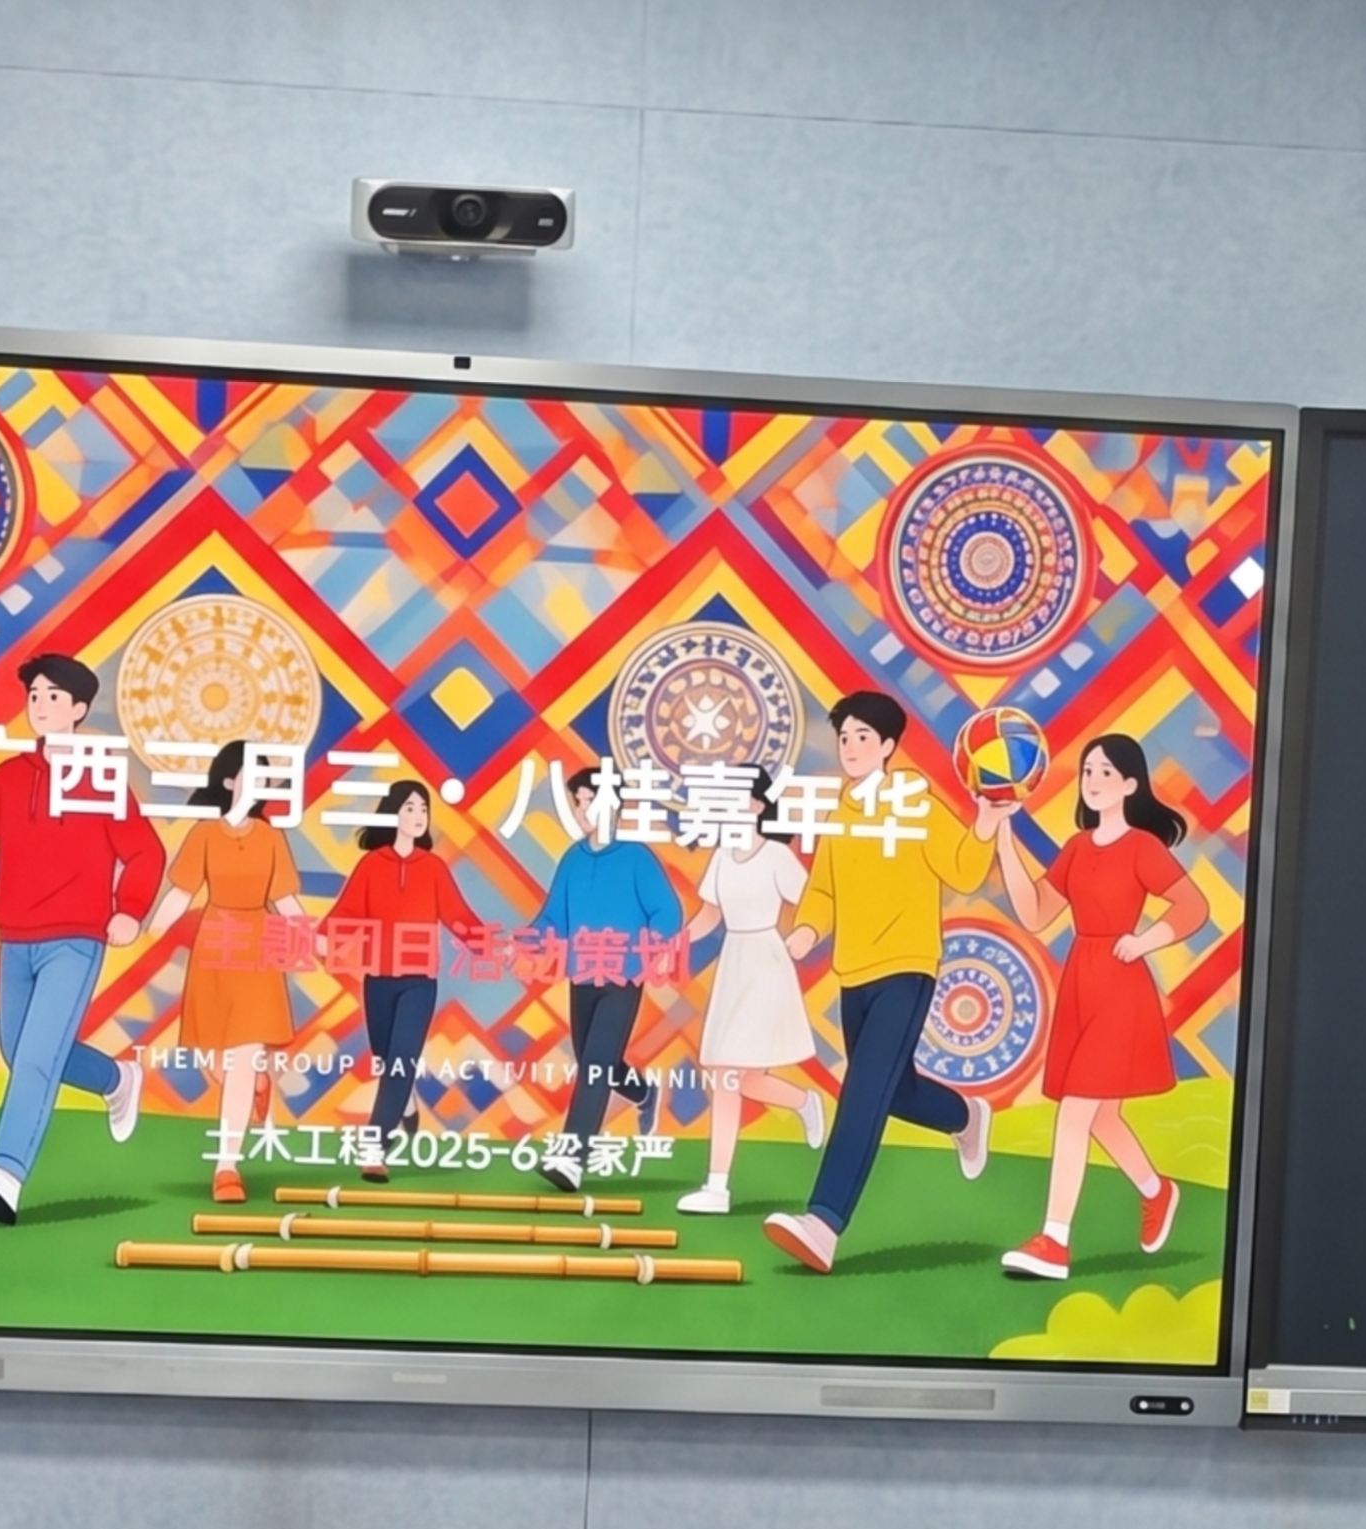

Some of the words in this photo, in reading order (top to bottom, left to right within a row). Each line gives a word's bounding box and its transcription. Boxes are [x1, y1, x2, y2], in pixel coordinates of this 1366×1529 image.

[198, 911, 691, 987] 主题团日活动策划
[131, 1045, 236, 1071] THEME
[251, 1050, 355, 1076] GROUP
[370, 1056, 427, 1079] DAY
[438, 1059, 578, 1084] ACTIVITY
[588, 1064, 740, 1091] PLANNING
[202, 1119, 675, 1178] 土木工程2025-6梁家严
